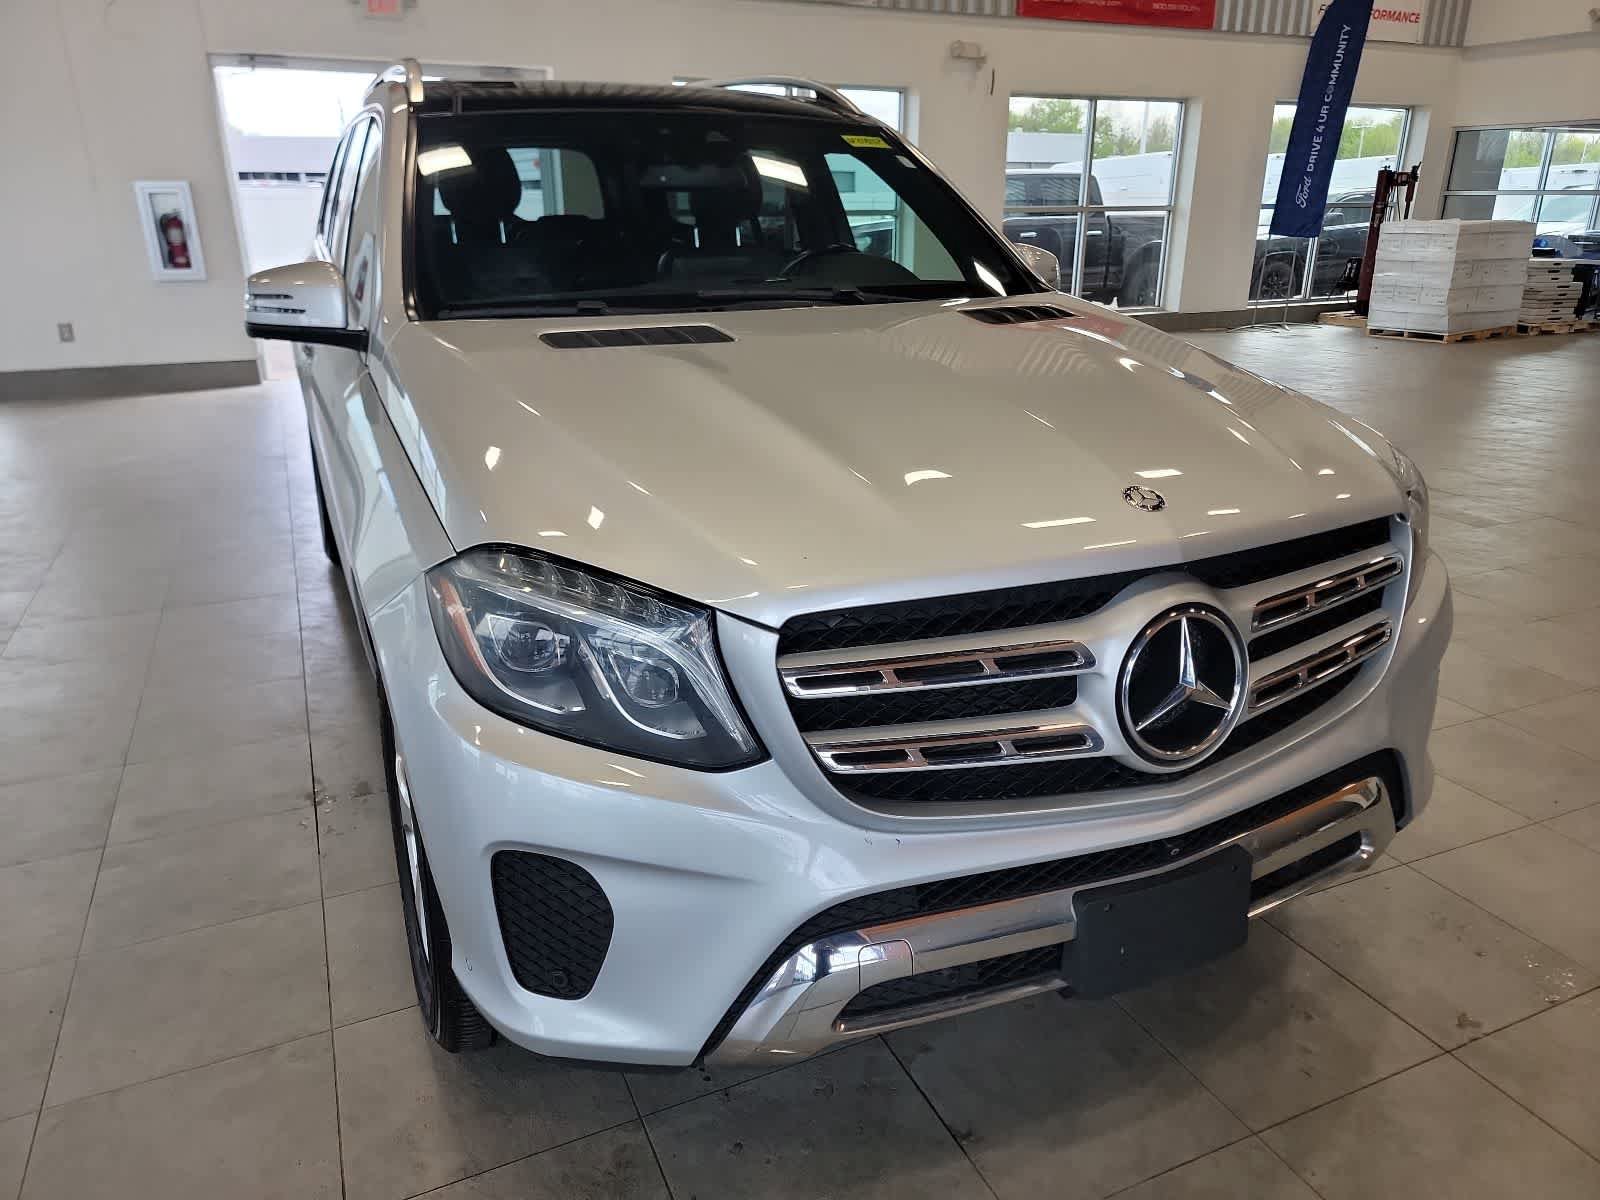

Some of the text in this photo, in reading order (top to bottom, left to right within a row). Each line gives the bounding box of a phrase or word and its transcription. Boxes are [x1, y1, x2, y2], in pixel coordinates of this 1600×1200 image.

[1296, 24, 1352, 208] Ford DRIVE 4 UR COMMUNITY
